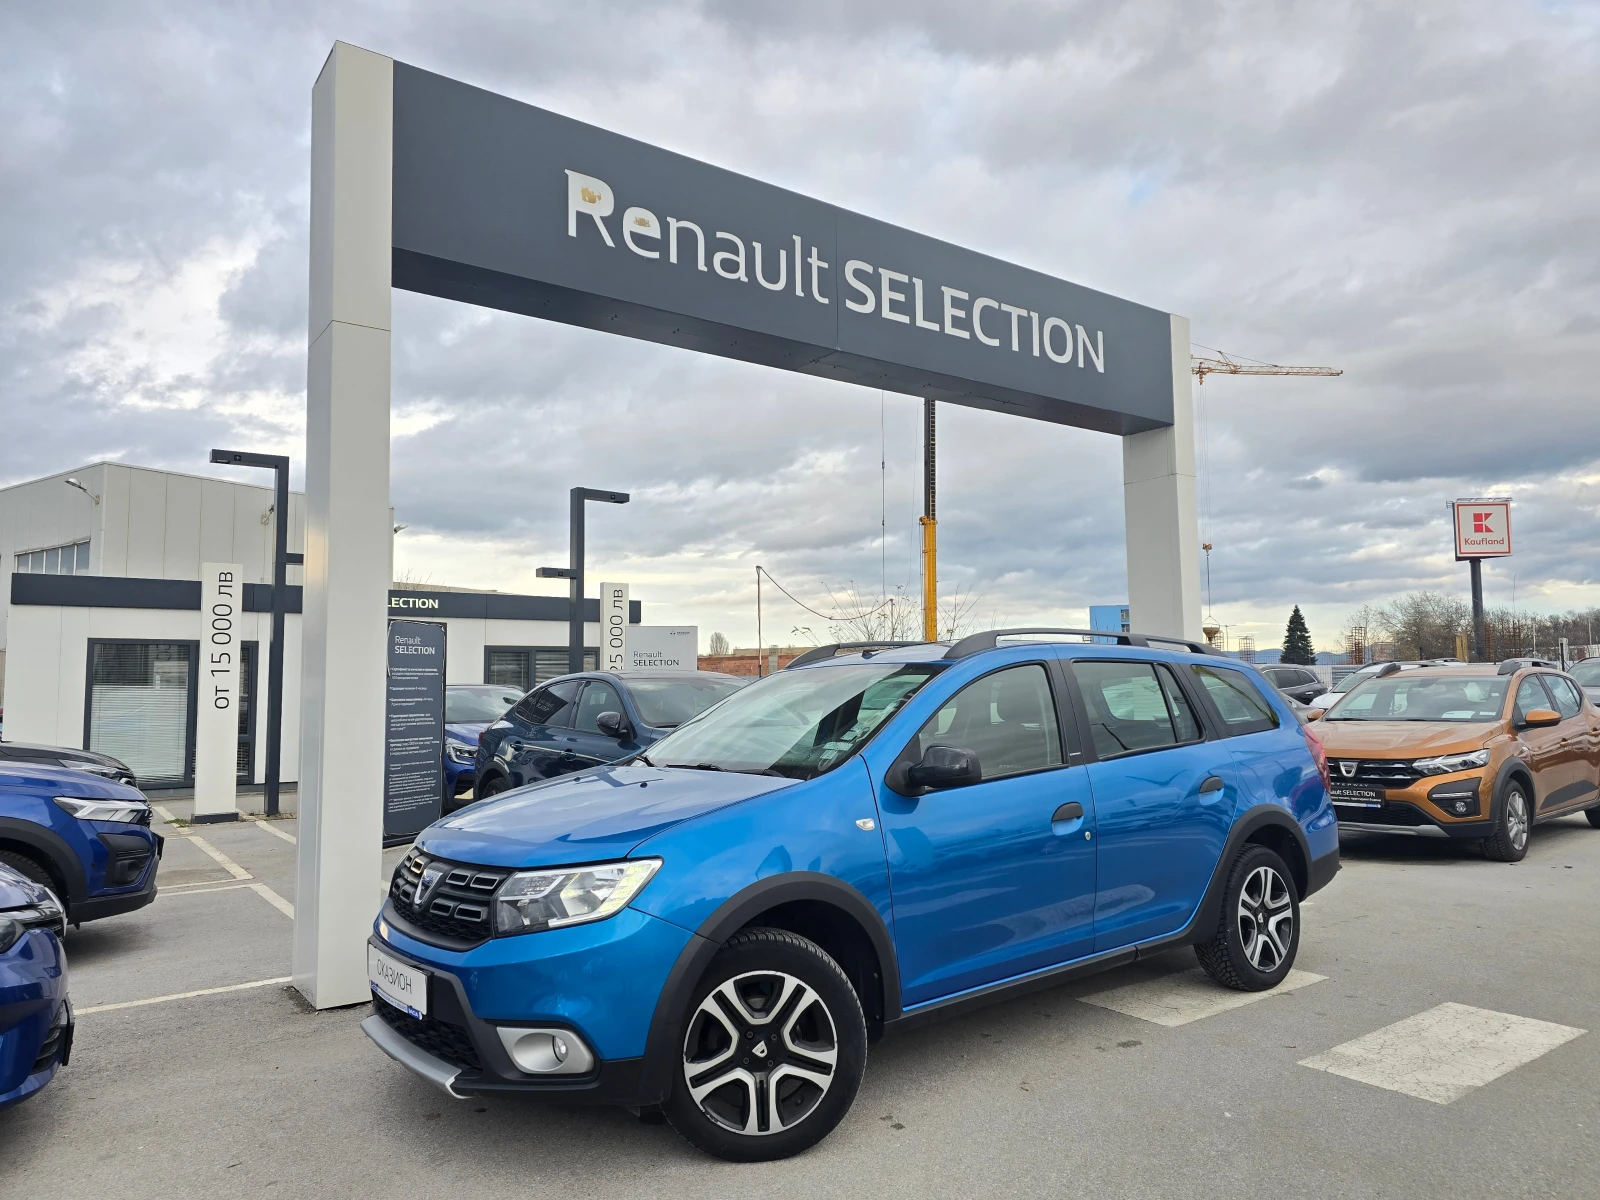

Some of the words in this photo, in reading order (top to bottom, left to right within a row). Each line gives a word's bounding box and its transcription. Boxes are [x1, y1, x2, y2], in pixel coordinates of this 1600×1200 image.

[564, 168, 829, 304] Renault
[844, 259, 1105, 374] SELECTION
[1464, 537, 1504, 545] Kaufland
[218, 571, 233, 598] лв
[388, 597, 439, 609] ECTION
[613, 589, 624, 611] лв
[211, 603, 232, 645] 000
[609, 614, 624, 649] 000
[394, 635, 421, 645] Renault
[394, 645, 435, 655] SELECTION
[210, 652, 231, 677] 15
[633, 659, 680, 667] SELECTION
[214, 685, 230, 710] от
[377, 959, 412, 994] ОКАЗИОН
